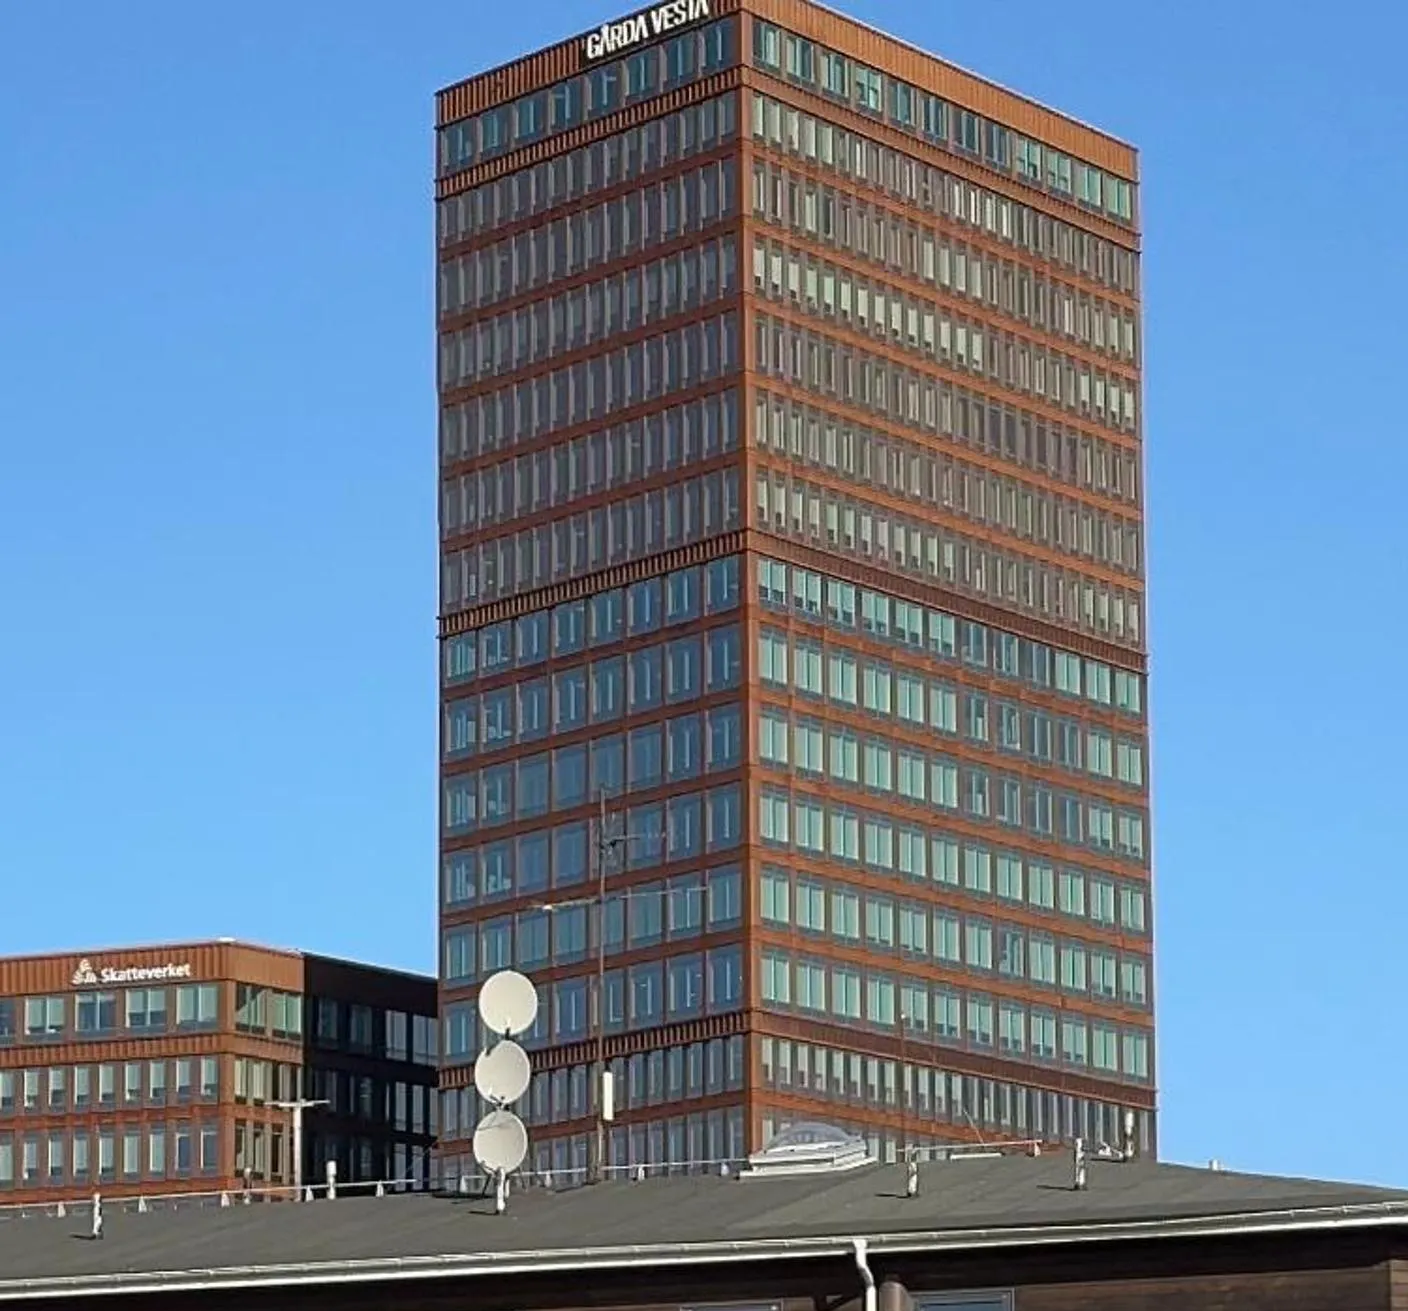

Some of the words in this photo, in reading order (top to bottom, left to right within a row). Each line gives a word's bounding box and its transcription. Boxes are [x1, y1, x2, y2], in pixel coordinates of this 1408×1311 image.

[587, 14, 648, 59] GÅRDA
[650, 0, 709, 34] VESTA
[101, 963, 191, 983] Skatteverket
